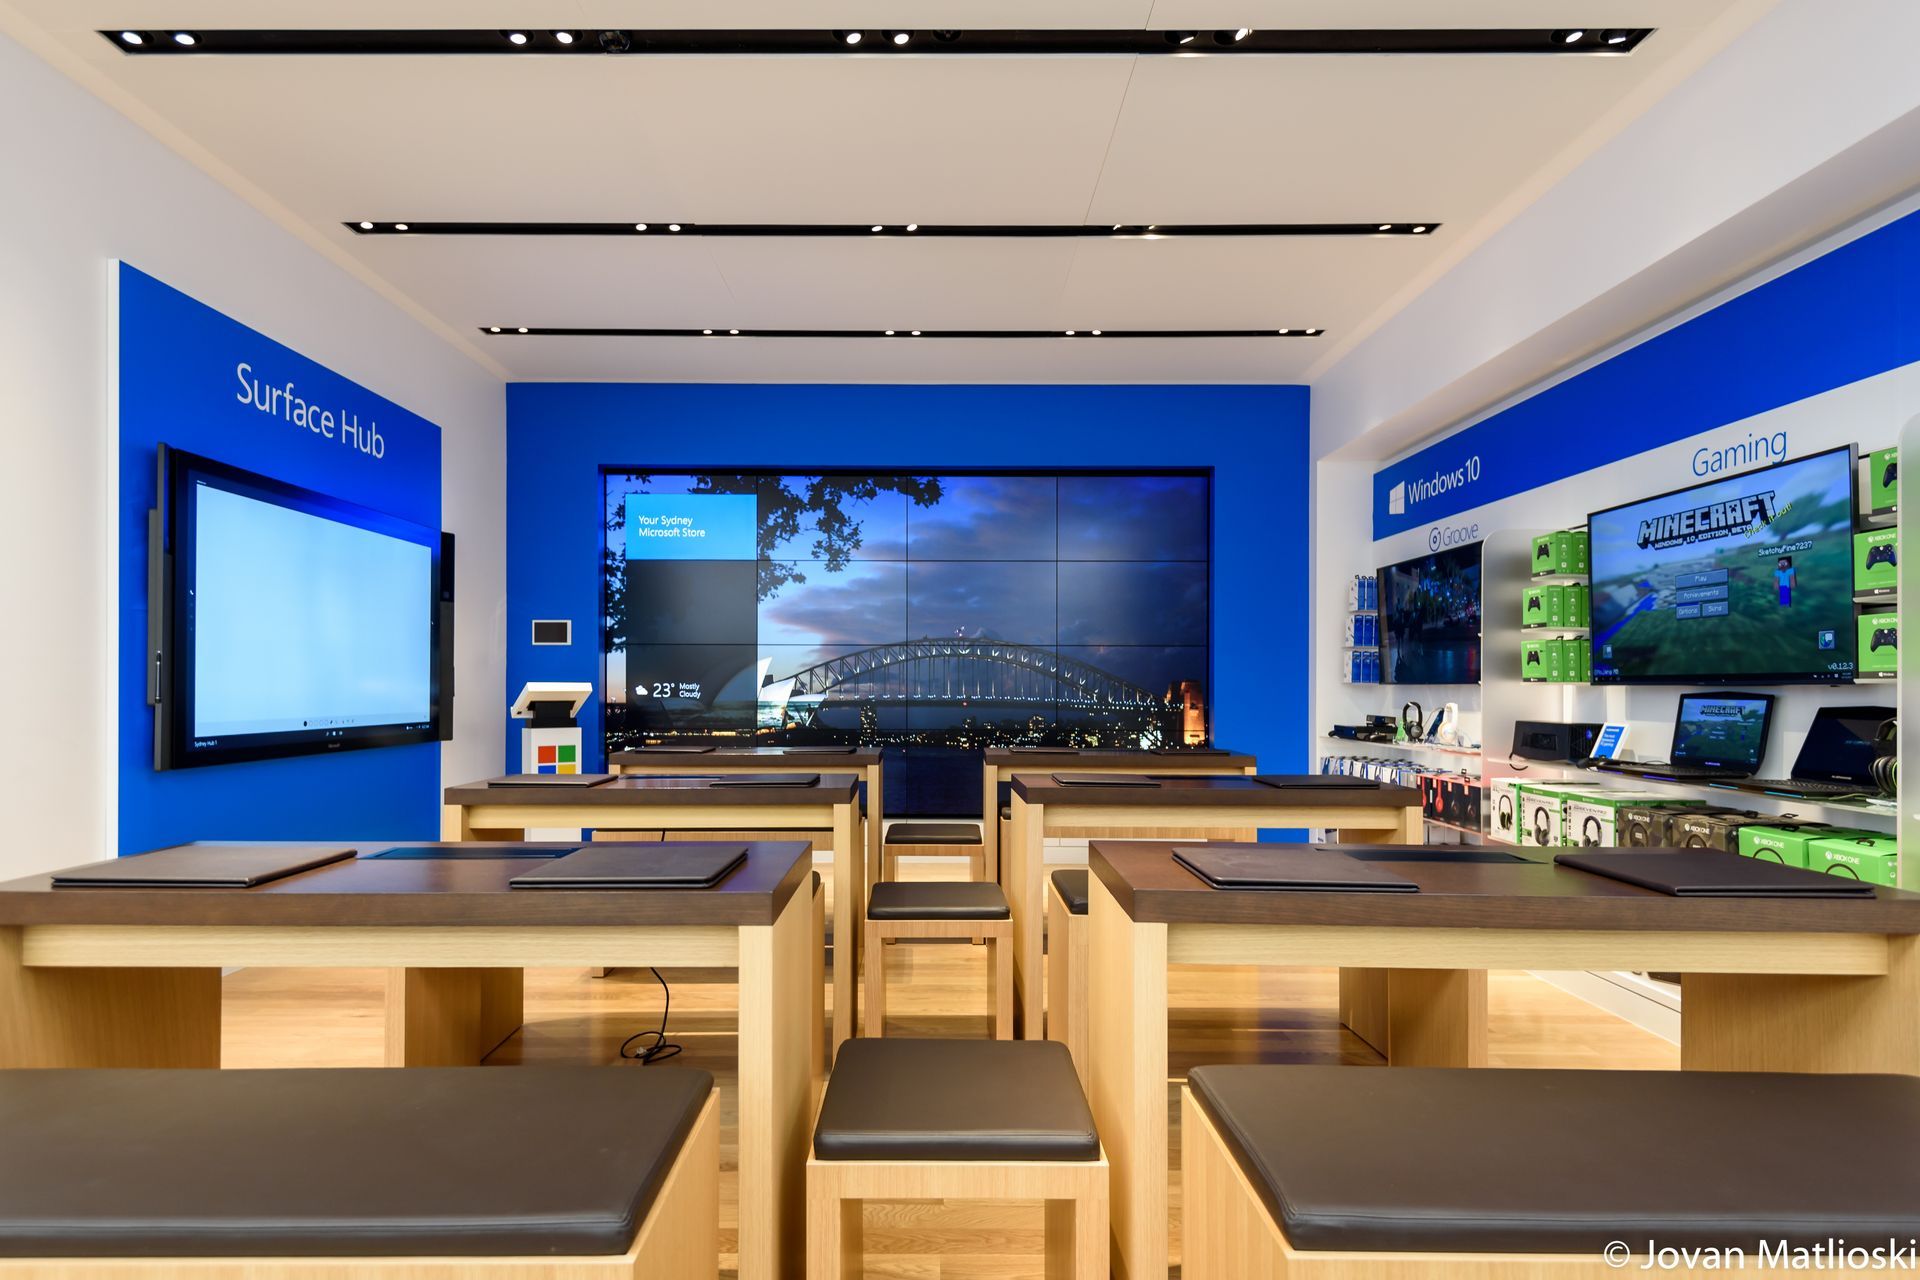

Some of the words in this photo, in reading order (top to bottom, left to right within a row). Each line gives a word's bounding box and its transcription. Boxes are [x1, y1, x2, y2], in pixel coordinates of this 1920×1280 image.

[236, 362, 335, 438] Surface
[341, 409, 385, 459] Hub
[1692, 431, 1787, 476] Gaming
[1408, 468, 1464, 505] Windows
[1465, 455, 1480, 483] 10
[638, 515, 659, 525] Your
[661, 515, 693, 527] Sydney
[1637, 490, 1776, 546] MINECRAFT
[639, 527, 680, 538] Microsoft
[682, 527, 706, 538] Store
[1443, 523, 1479, 546] Groove
[1654, 537, 1683, 549] WINDOWS
[1698, 529, 1729, 540] EDITION
[1731, 524, 1753, 533] BETA
[652, 682, 675, 698] 23°
[679, 682, 700, 691] Mostly
[679, 690, 701, 700] Cloudy
